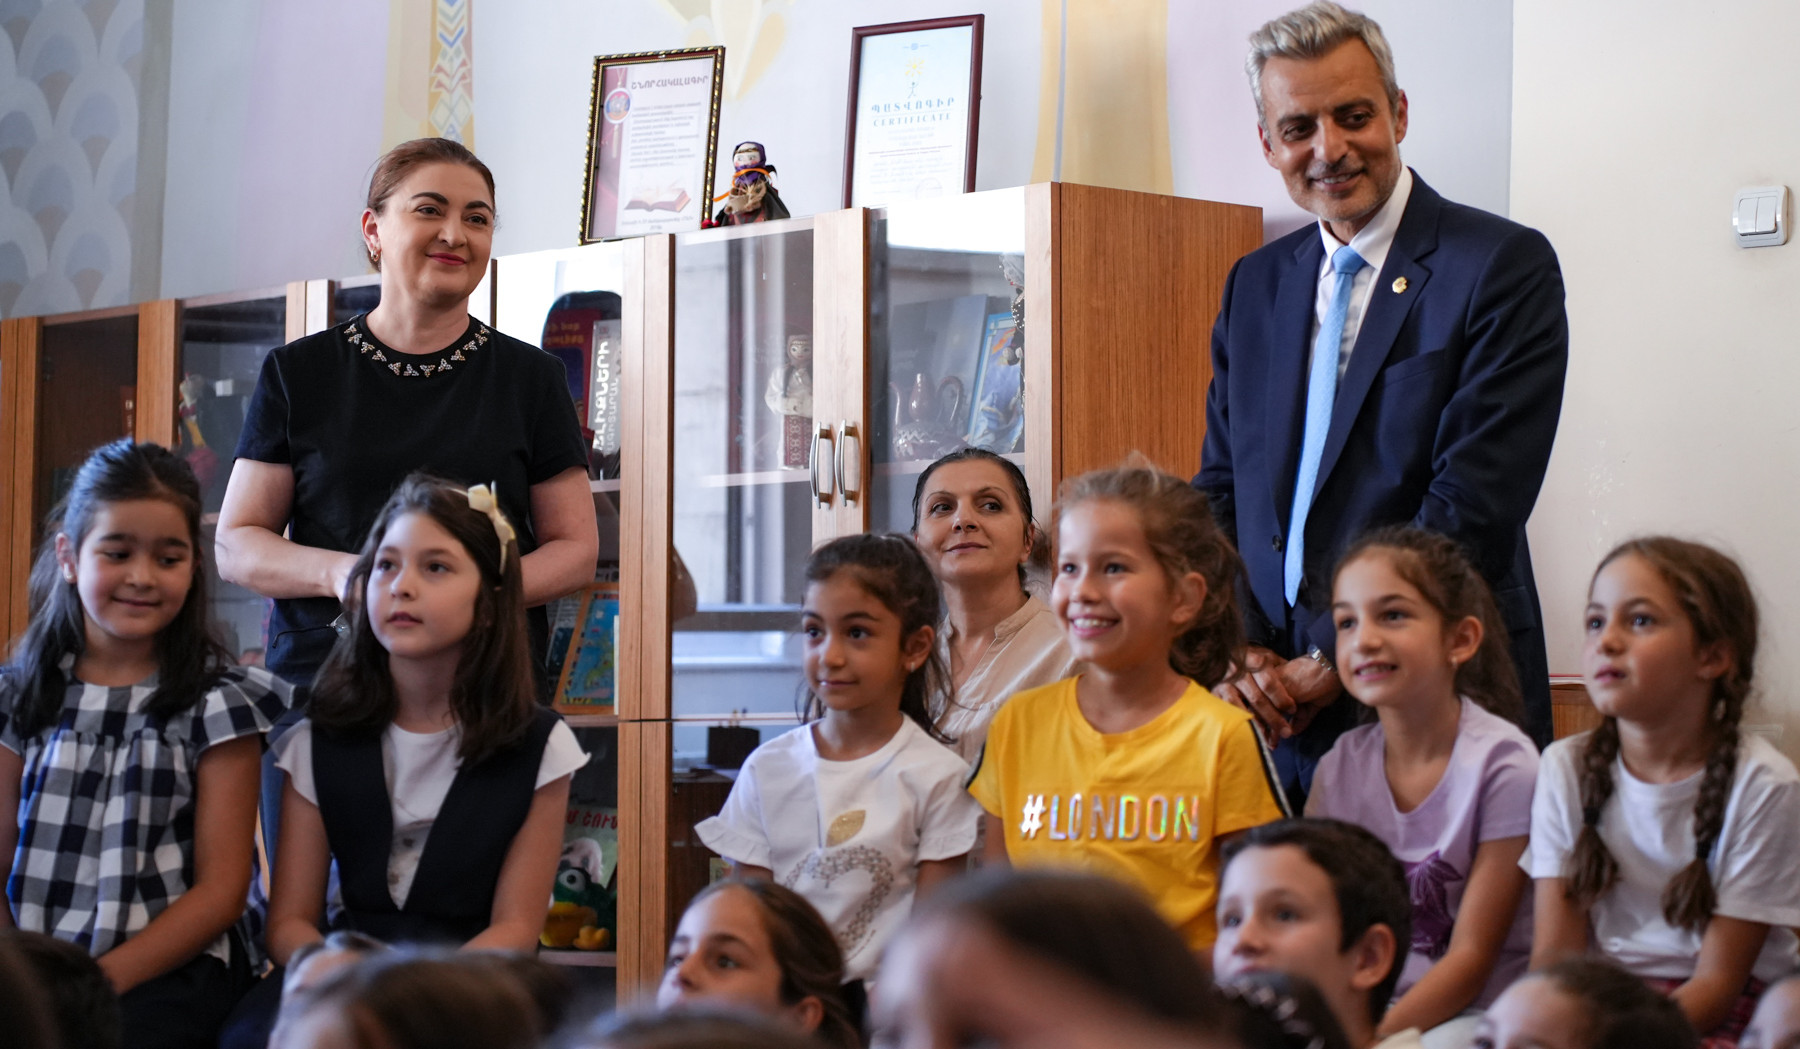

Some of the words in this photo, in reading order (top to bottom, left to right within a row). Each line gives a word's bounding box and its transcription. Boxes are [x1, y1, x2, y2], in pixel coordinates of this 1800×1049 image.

[631, 75, 709, 90] ՇՆՈՐՀԱԿԱԼԱԳԻՐ
[871, 97, 955, 113] ՊԱՏՎՈԳԻՐ
[873, 112, 950, 127] CERTIFICATE
[604, 378, 619, 453] ԱԳԻՏԱՐԱՆ
[1019, 793, 1200, 842] #LONDON
